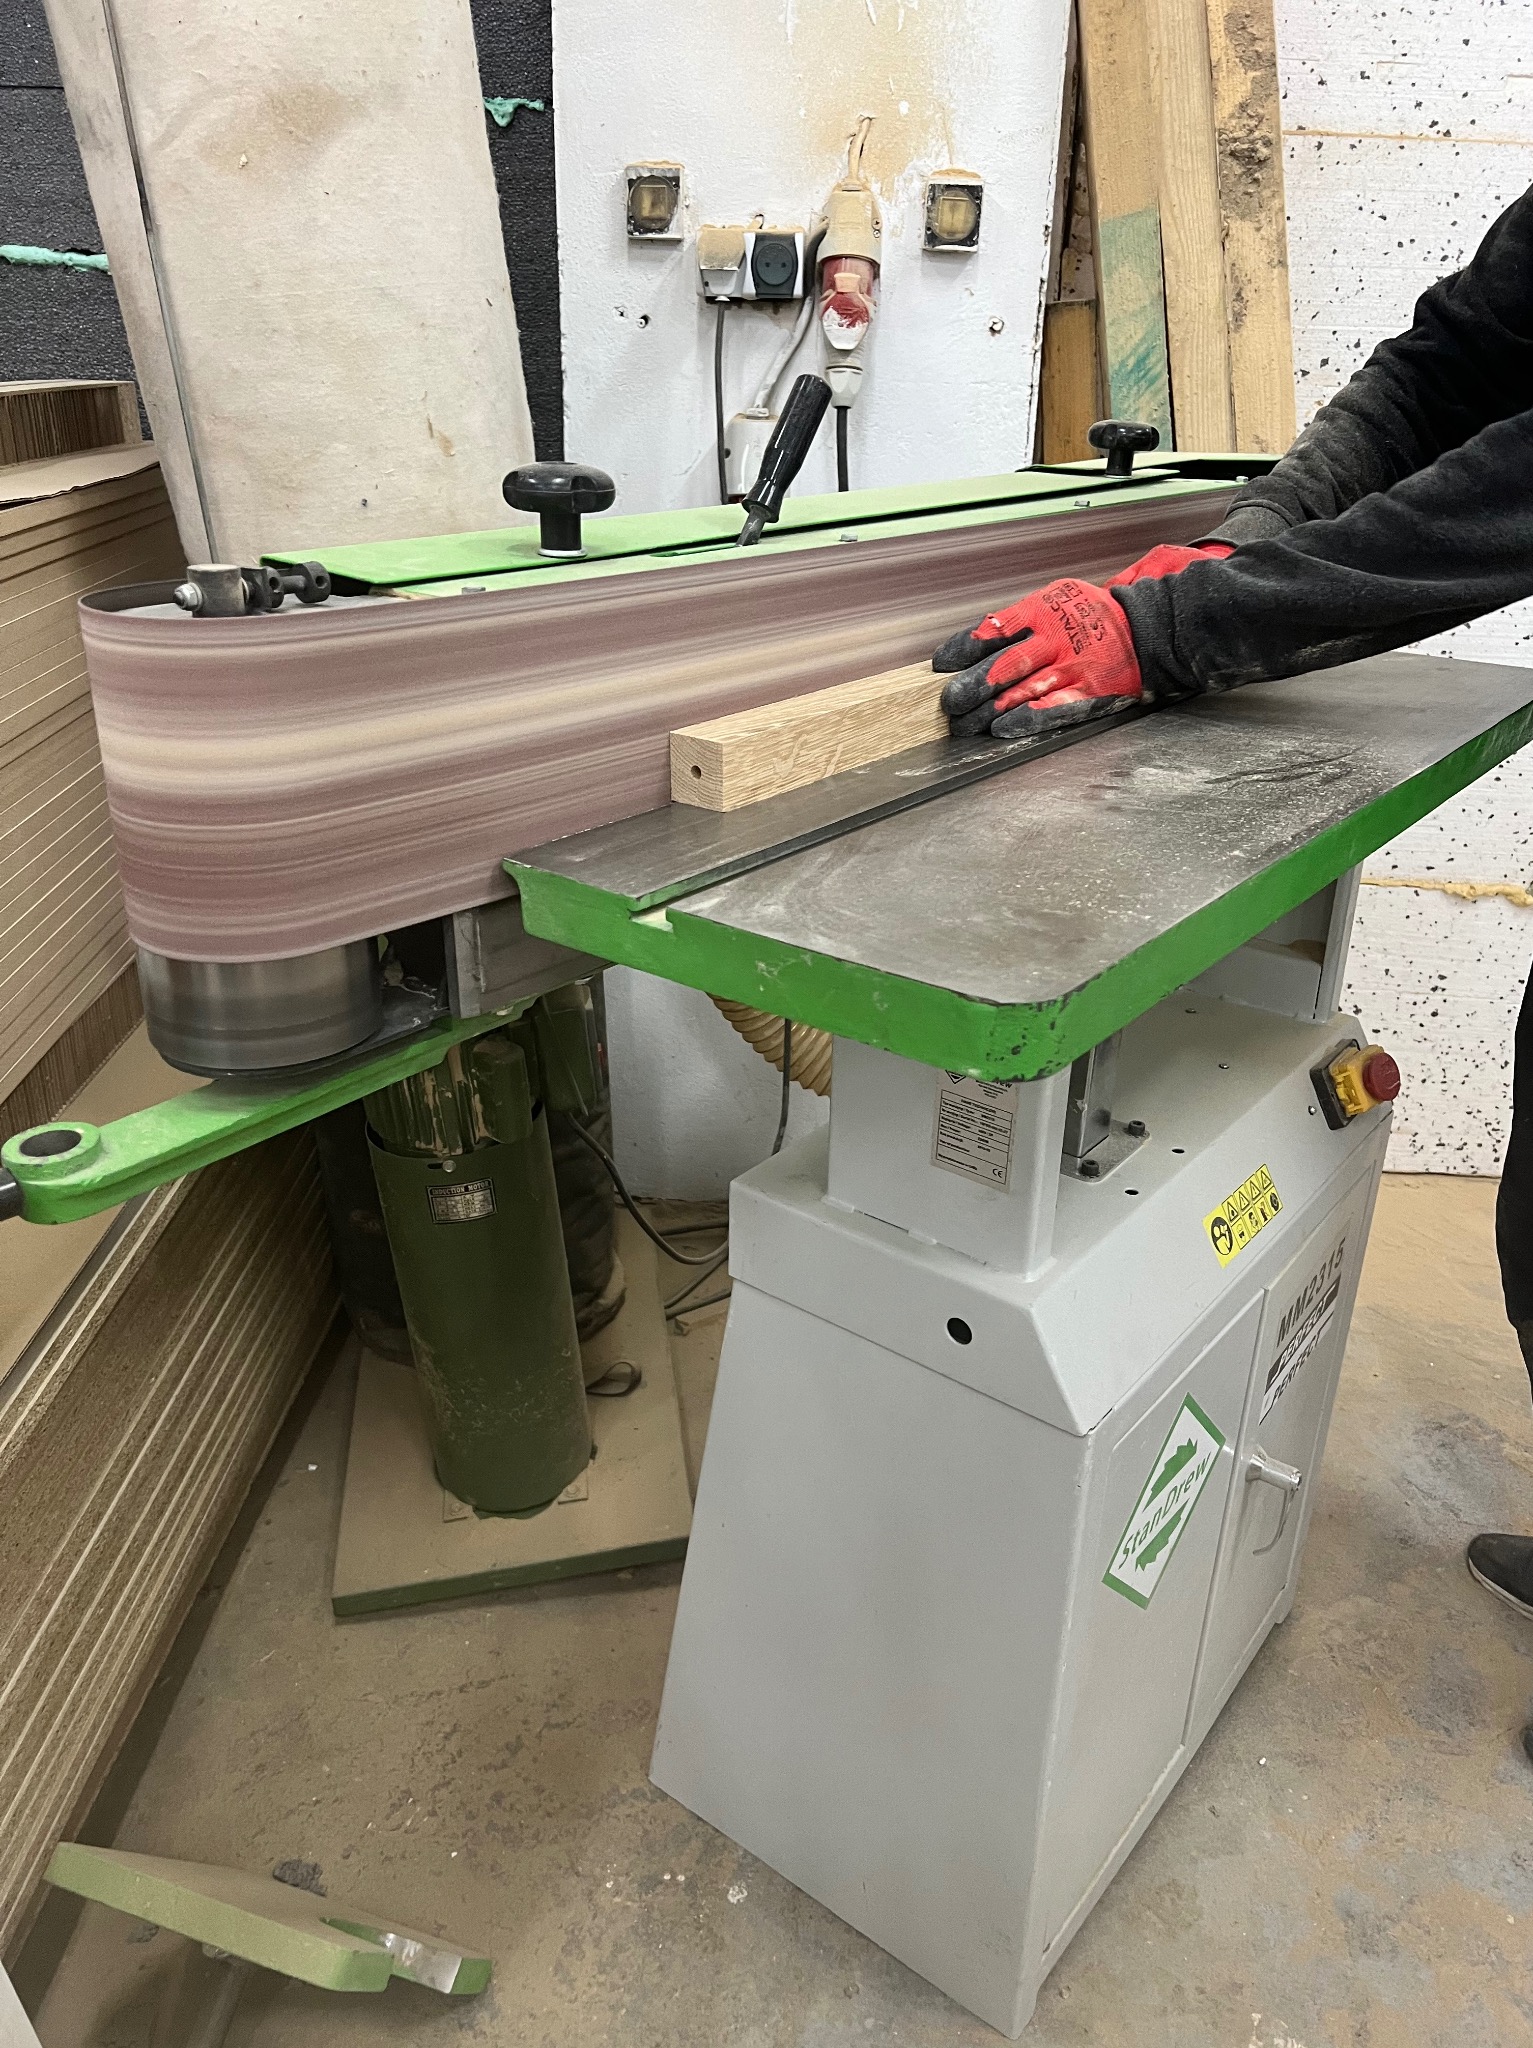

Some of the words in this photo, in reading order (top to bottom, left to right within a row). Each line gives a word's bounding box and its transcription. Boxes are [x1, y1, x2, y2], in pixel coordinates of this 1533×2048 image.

[432, 1187, 465, 1195] INDUCTION
[468, 1181, 489, 1191] MOTOR
[1272, 1287, 1334, 1381] PERFECT
[1277, 1236, 1346, 1348] MM2315
[1265, 1316, 1331, 1415] PERFECT
[1118, 1451, 1211, 1569] StanDrew
